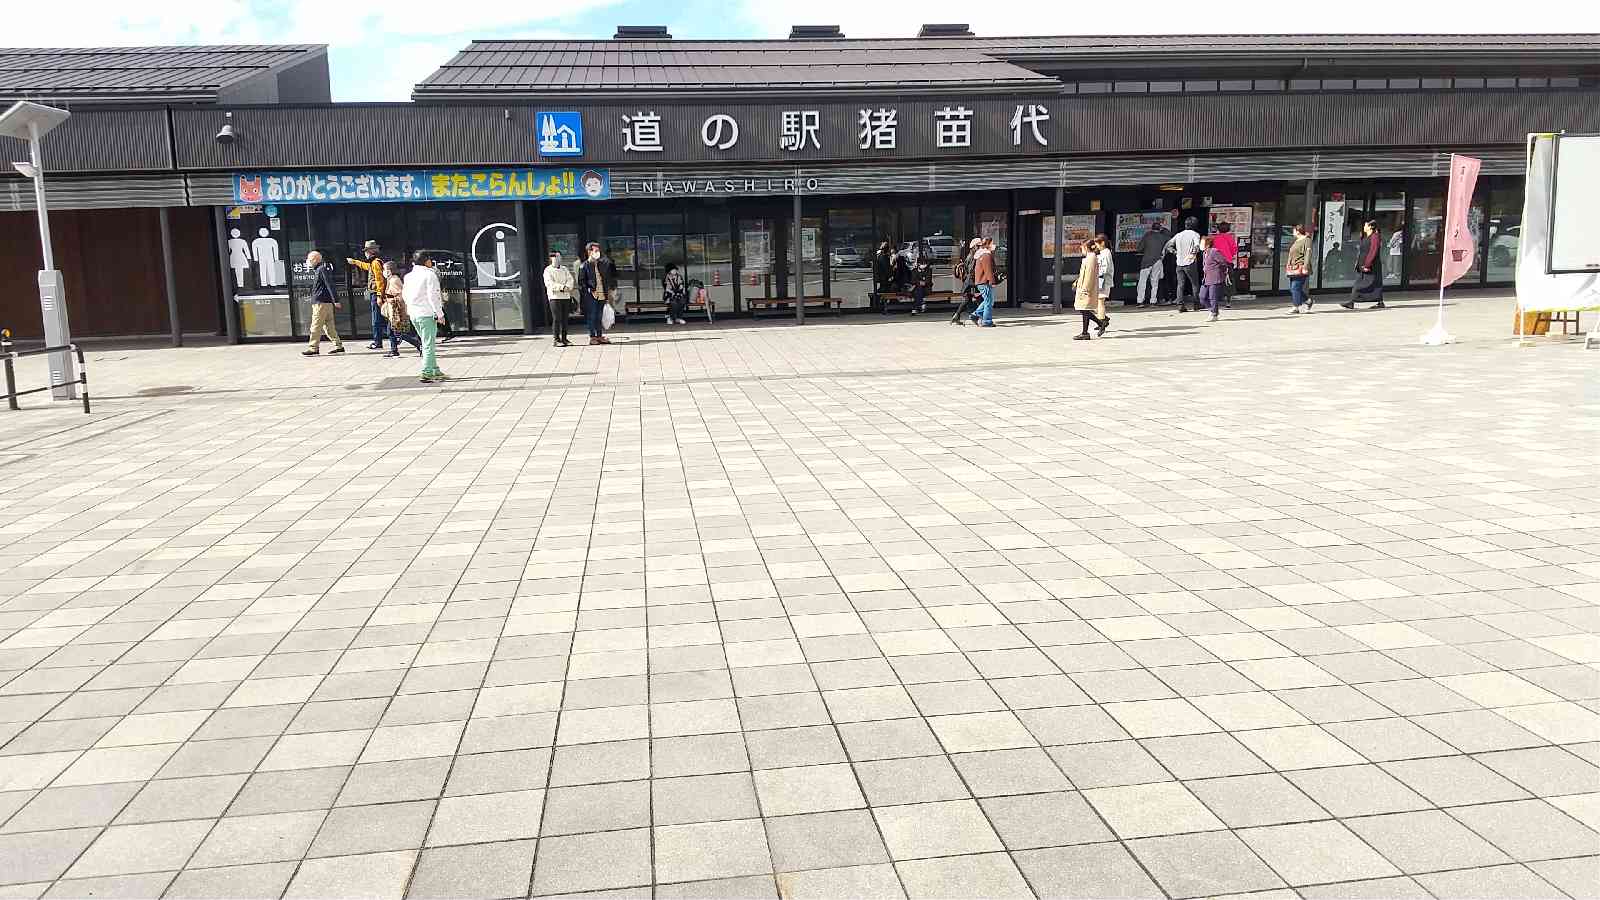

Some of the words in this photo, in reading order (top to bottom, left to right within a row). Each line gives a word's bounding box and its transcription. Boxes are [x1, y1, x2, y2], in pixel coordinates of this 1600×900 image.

[621, 104, 1050, 154] 道の駅猪苗代
[266, 173, 421, 201] ありがとうございます。
[624, 178, 820, 196] INAWASHIRO
[293, 262, 334, 273] お手い
